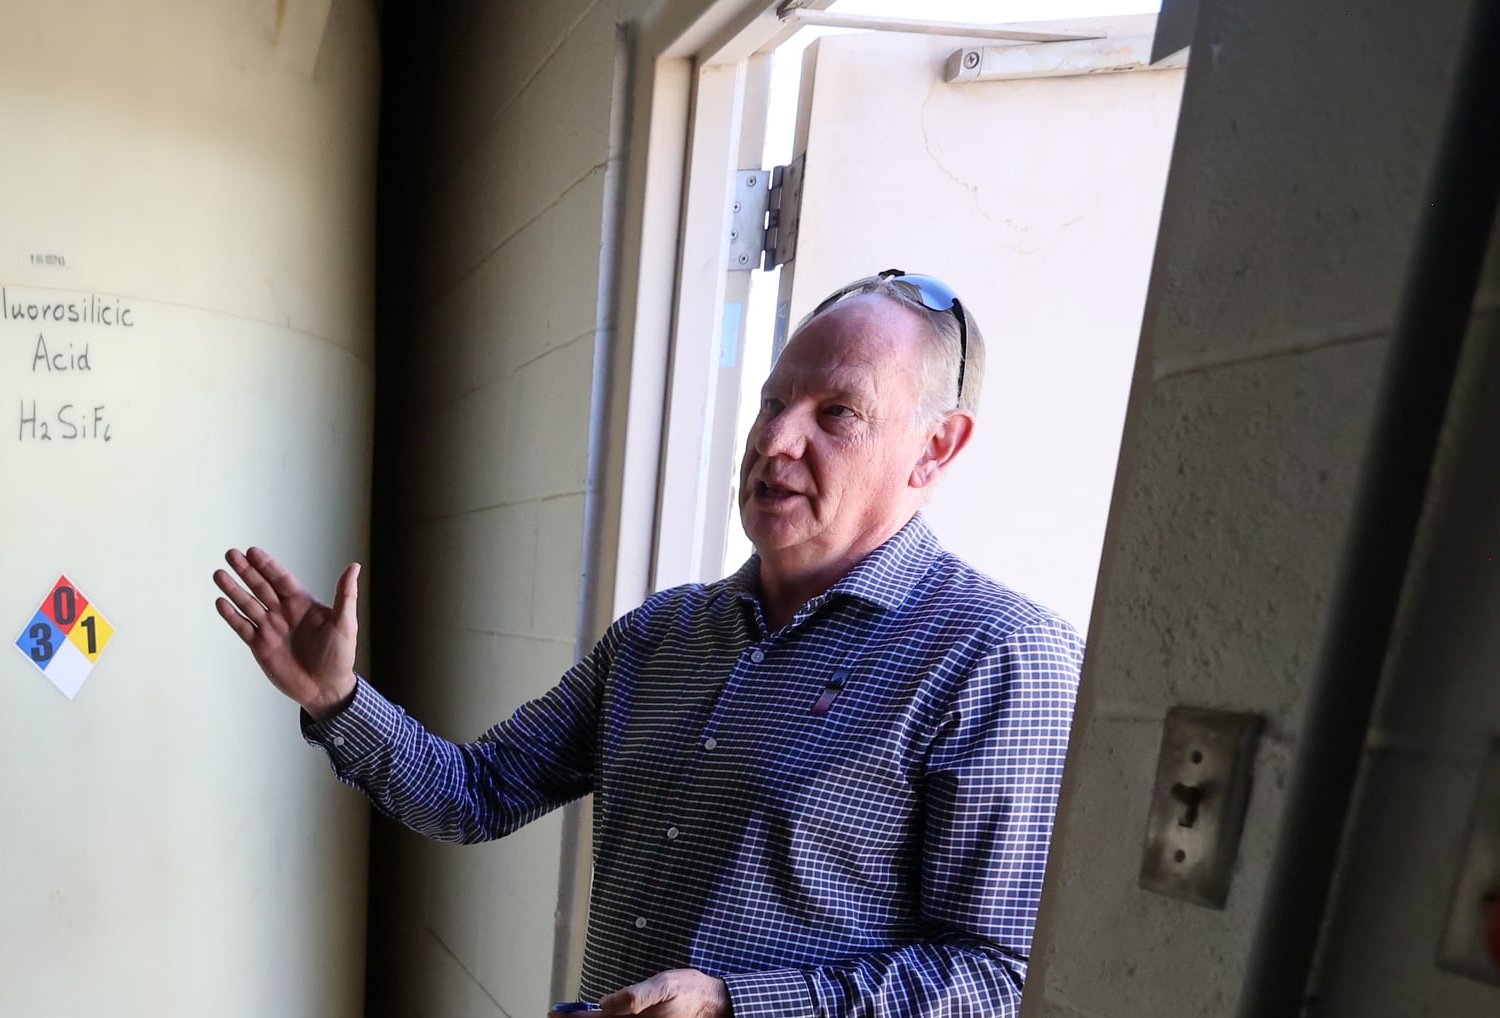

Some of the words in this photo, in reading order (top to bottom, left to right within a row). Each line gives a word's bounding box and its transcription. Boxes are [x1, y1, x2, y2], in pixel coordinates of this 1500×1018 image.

[32, 332, 91, 372] Acid
[53, 585, 76, 625] 0
[29, 622, 54, 662] 3
[80, 615, 97, 654] 1
